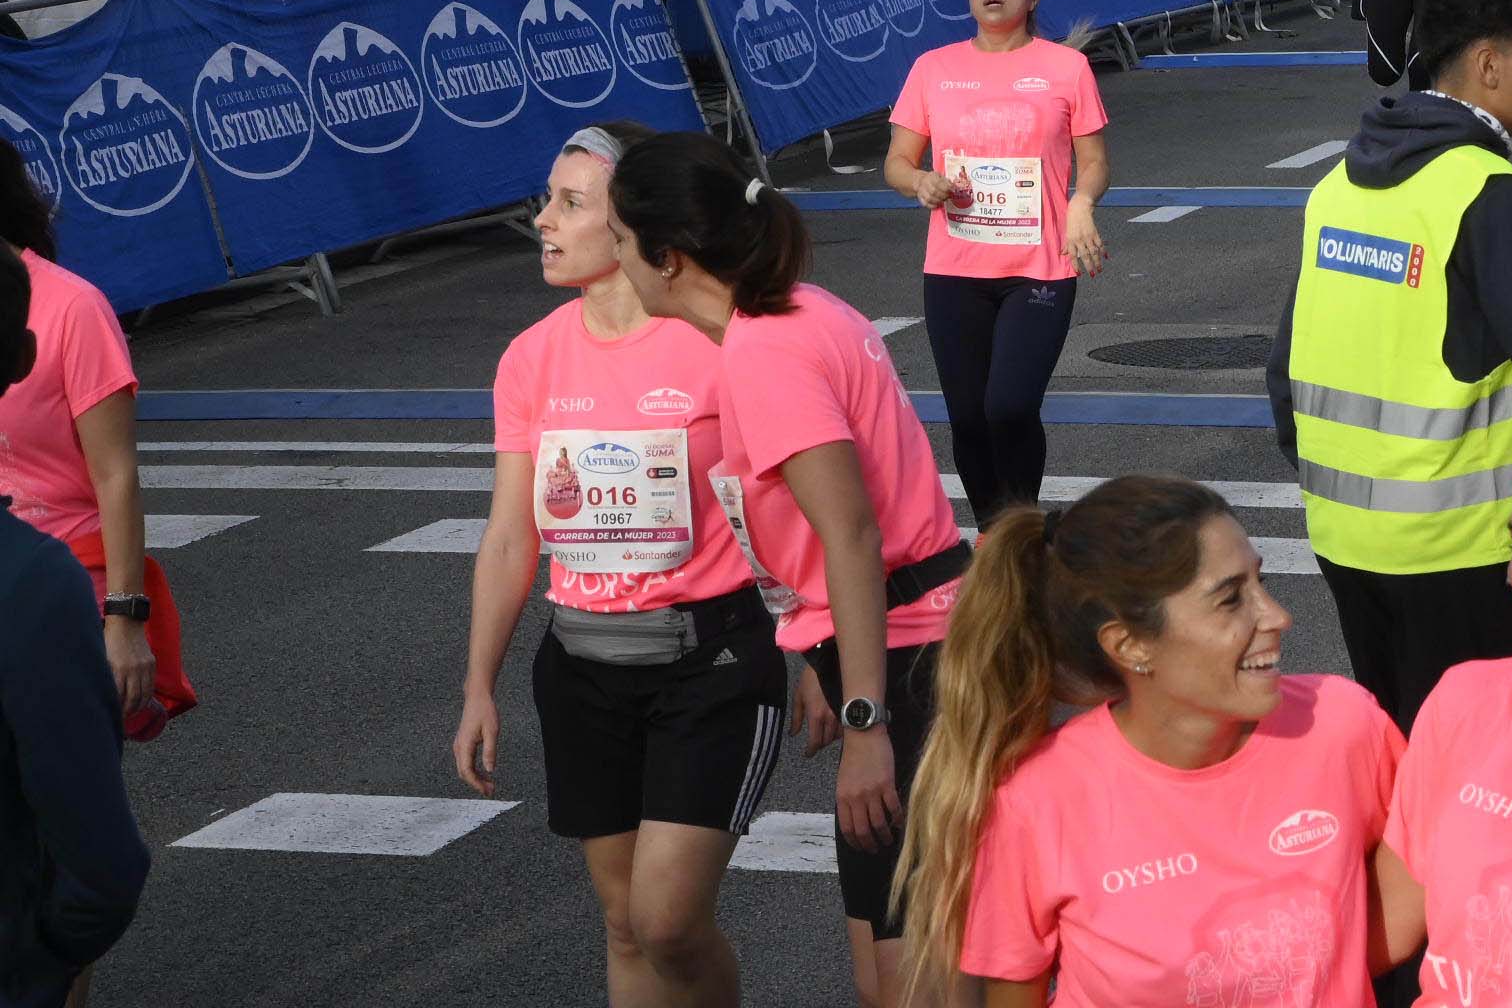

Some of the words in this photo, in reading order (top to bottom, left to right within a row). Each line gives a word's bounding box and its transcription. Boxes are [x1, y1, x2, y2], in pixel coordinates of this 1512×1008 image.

[526, 37, 612, 83] ASTURIANA
[431, 53, 523, 101] ASTURIANA
[318, 76, 419, 127] ASTURIANA
[204, 98, 309, 152] ASTURIANA
[72, 129, 186, 189] ASTURIANA
[976, 191, 1007, 205] 016
[979, 207, 1003, 216] 18477
[1320, 238, 1404, 273] VOLUNTARIS
[548, 396, 594, 412] YSHO
[583, 454, 635, 469] ASTURIANA
[645, 449, 675, 457] SUMA
[587, 486, 638, 507] 016
[593, 512, 633, 525] 10967
[554, 532, 595, 541] CARRERA
[597, 532, 610, 540] DE
[611, 532, 623, 540] LA
[625, 531, 654, 540] MUJER
[656, 531, 677, 539] 2023
[634, 549, 681, 562] Santander
[1276, 823, 1335, 851] ASTURIANA
[1102, 853, 1199, 894] OYSHO
[1425, 952, 1473, 1007] TU
